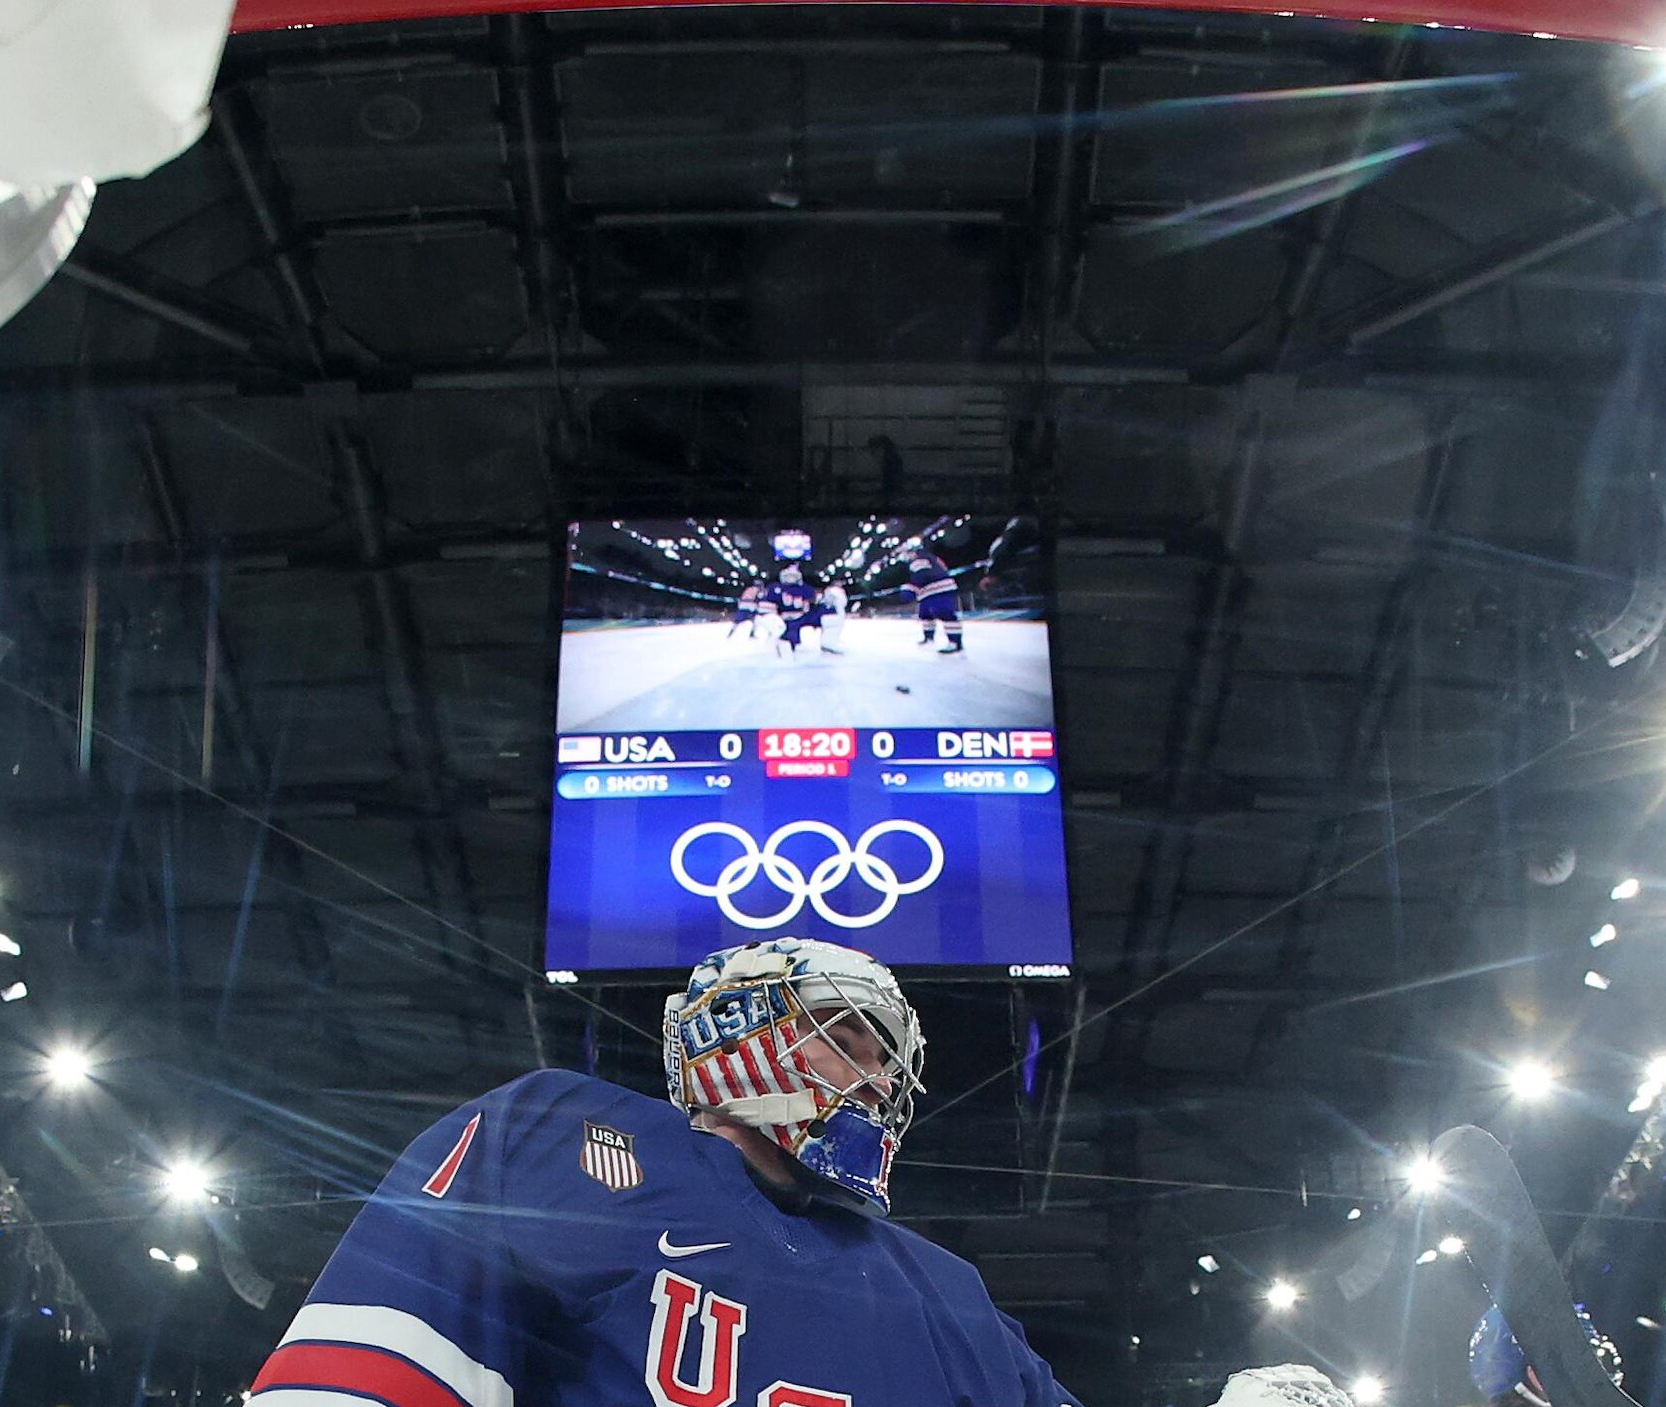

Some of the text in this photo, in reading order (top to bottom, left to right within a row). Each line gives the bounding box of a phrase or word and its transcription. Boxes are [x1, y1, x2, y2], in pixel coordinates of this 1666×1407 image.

[604, 731, 1010, 763] USA 0 18:20 0 DEN
[584, 775, 600, 794] 0
[606, 775, 668, 793] SHOTS
[943, 771, 1006, 789] SHOTS
[1013, 770, 1029, 789] 0
[1023, 964, 1071, 977] OMEGA
[688, 992, 777, 1049] USA
[592, 1127, 626, 1149] USA
